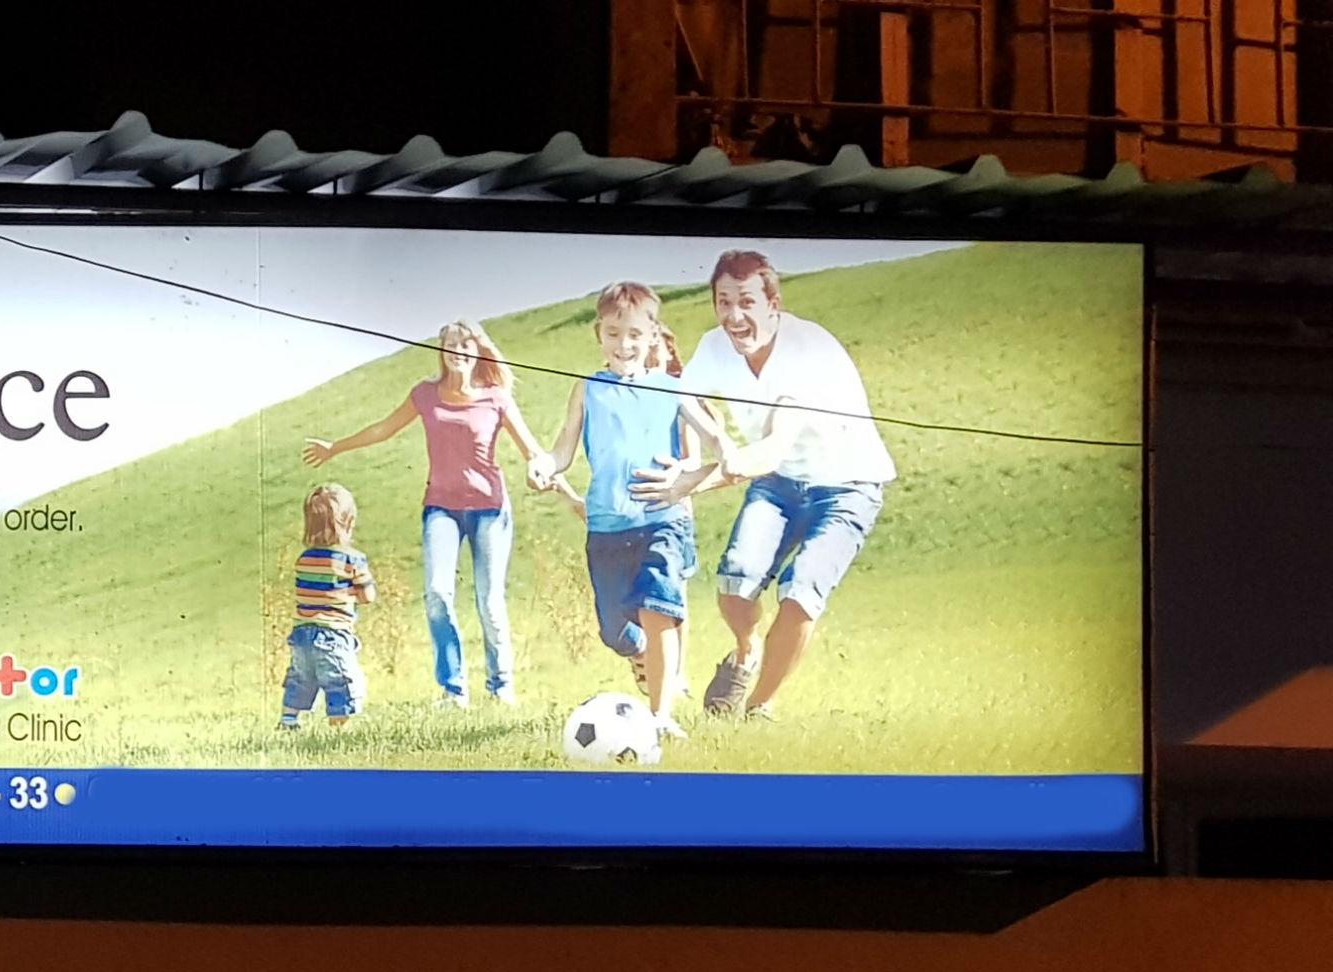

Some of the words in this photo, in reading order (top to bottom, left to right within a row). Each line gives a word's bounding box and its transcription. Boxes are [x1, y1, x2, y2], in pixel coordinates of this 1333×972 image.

[4, 504, 83, 532] order.
[8, 713, 82, 741] Clinic
[9, 776, 48, 810] 33
